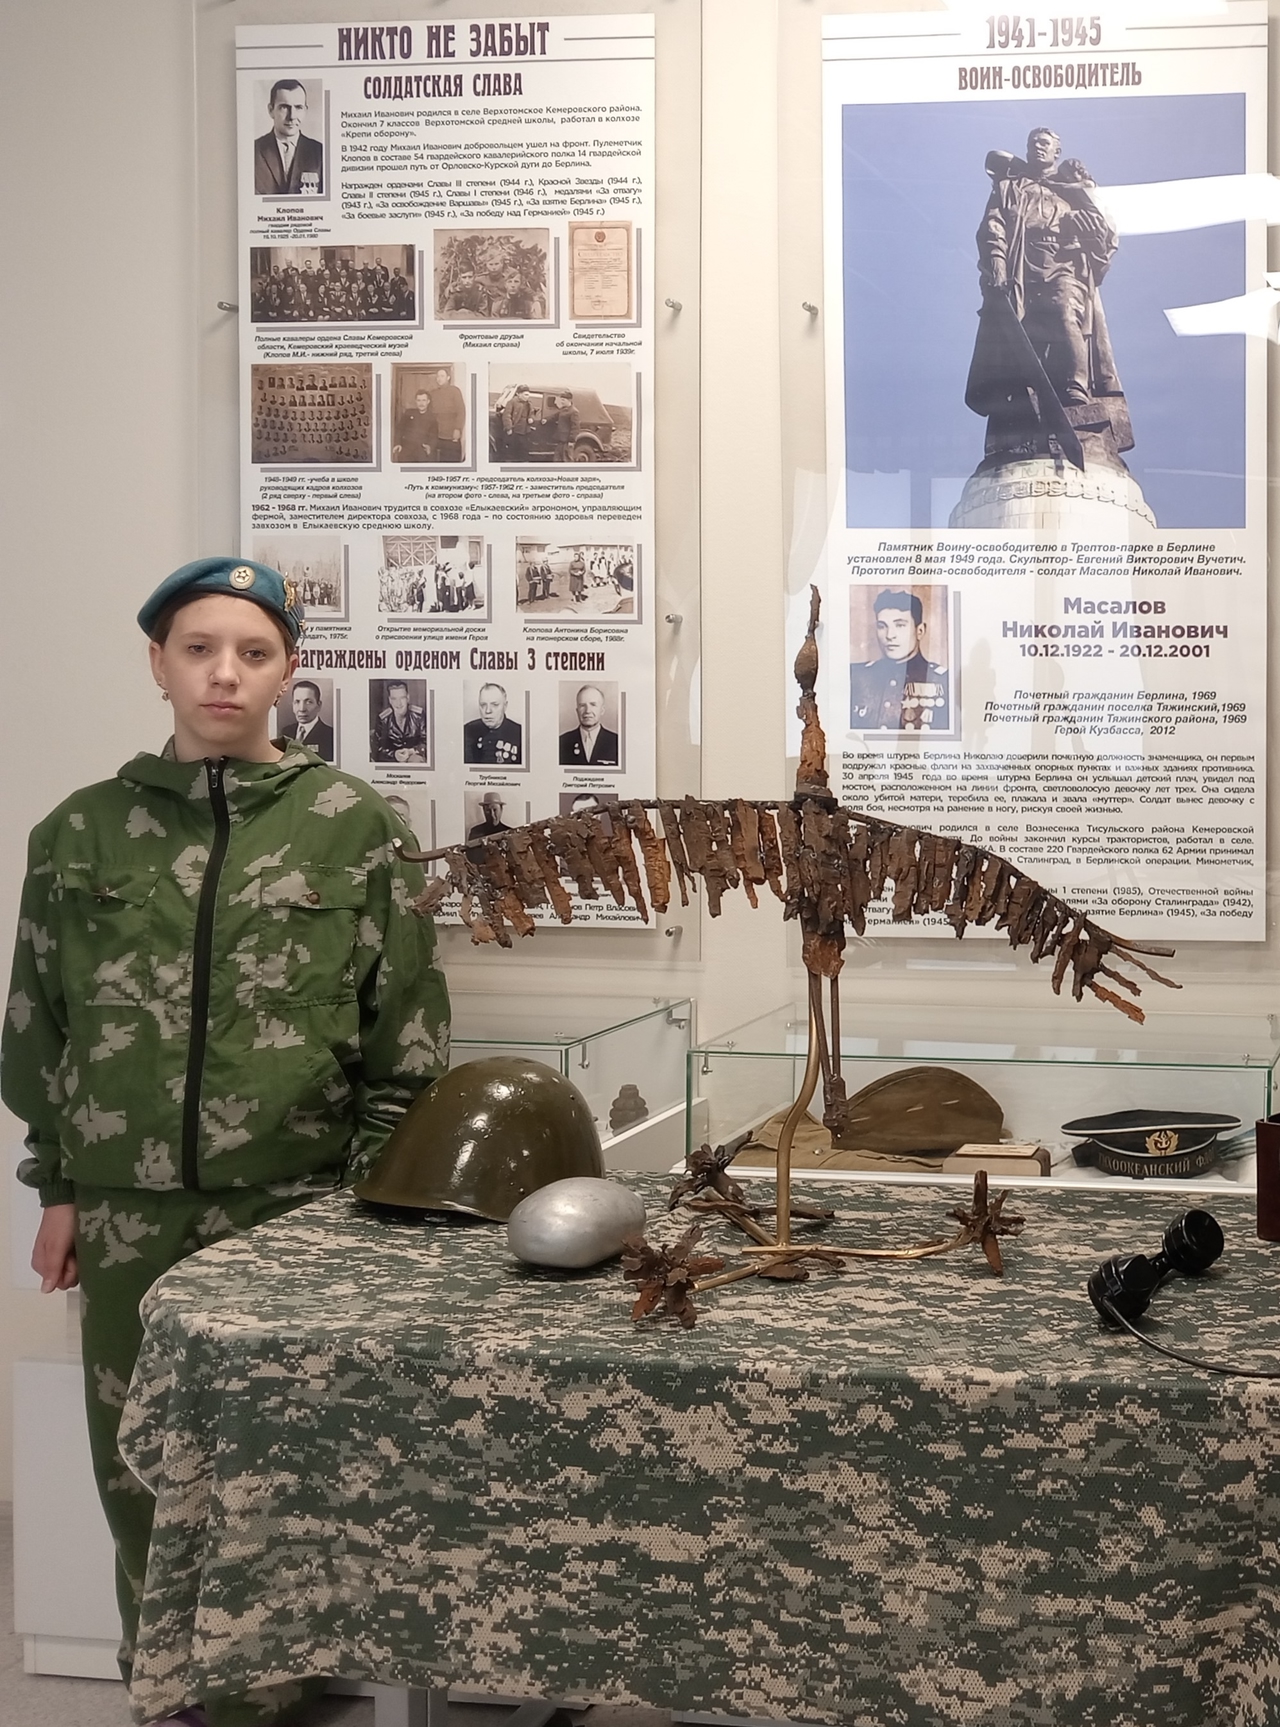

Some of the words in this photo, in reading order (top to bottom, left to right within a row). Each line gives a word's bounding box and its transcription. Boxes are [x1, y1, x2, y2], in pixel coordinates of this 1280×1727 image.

[337, 26, 412, 60] НИКТО
[426, 24, 455, 58] НЕ
[469, 22, 549, 56] ЗАБЫТ
[958, 62, 1141, 89] ВОИН-ОСВОБОДИТЕЛЬ
[363, 74, 462, 99] СОЛДАТСКАЯ
[473, 73, 522, 96] СЛАВА
[483, 107, 543, 115] Верхотомское
[545, 106, 606, 114] Кемеровского
[340, 120, 377, 128] Окончил
[424, 118, 485, 126] Верхотомской
[487, 116, 522, 125] средней
[560, 115, 595, 124] работал
[877, 542, 933, 551] Памятник
[936, 542, 1057, 553] Воину-освободителю
[1070, 542, 1153, 553] Трептов-парке
[1166, 542, 1215, 553] Берлине
[847, 555, 912, 564] установлен
[950, 554, 974, 563] 1949
[1076, 554, 1122, 563] Евгений
[1126, 554, 1194, 565] Викторович
[851, 565, 904, 576] Прототип
[908, 565, 1026, 576] Воина-освободителя
[1037, 568, 1077, 576] солдат
[1079, 566, 1129, 575] Масалов
[1132, 566, 1181, 575] Николай
[1063, 597, 1165, 614] Масалов
[1002, 620, 1104, 638] Николай
[1112, 622, 1227, 638] Иванович
[1019, 644, 1102, 657] 10.12.1922
[1119, 644, 1209, 657] 20.12.2001
[295, 646, 386, 671] аграждены
[395, 650, 460, 670] орденом
[470, 647, 518, 670] Славы
[545, 652, 604, 670] степени
[1013, 690, 1069, 699] Почетный
[1072, 692, 1133, 701] гражданин
[1192, 691, 1216, 700] 1969
[984, 701, 1040, 711] Почетный
[1043, 703, 1104, 712] гражданин
[983, 712, 1039, 722] Почетный
[1042, 715, 1103, 724] гражданин
[1107, 713, 1172, 723] Тяжинского
[1223, 714, 1247, 723] 1969
[1054, 725, 1086, 735] Герой
[1149, 725, 1175, 734] 2012
[1025, 824, 1079, 832] Вознесенка
[1086, 824, 1144, 833] Тисульского
[1151, 825, 1184, 833] района
[1192, 825, 1254, 834] Кемеровской
